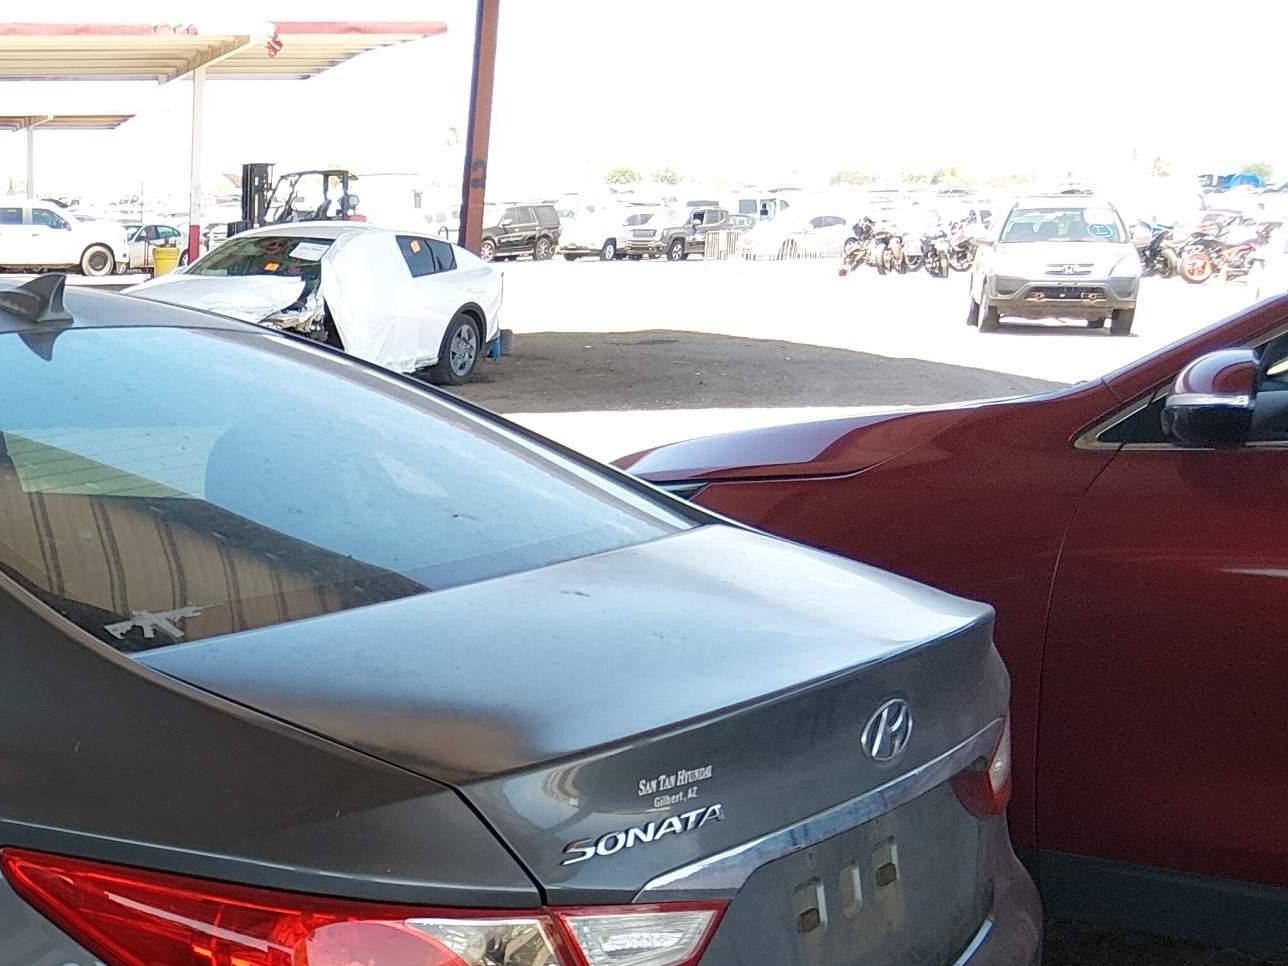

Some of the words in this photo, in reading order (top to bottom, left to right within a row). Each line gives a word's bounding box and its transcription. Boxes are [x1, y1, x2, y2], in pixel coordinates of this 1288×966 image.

[638, 779, 658, 796] SAN
[658, 774, 677, 791] TAN
[677, 765, 713, 786] HYUNDAI
[687, 786, 699, 799] AZ
[561, 803, 725, 866] SONATA
